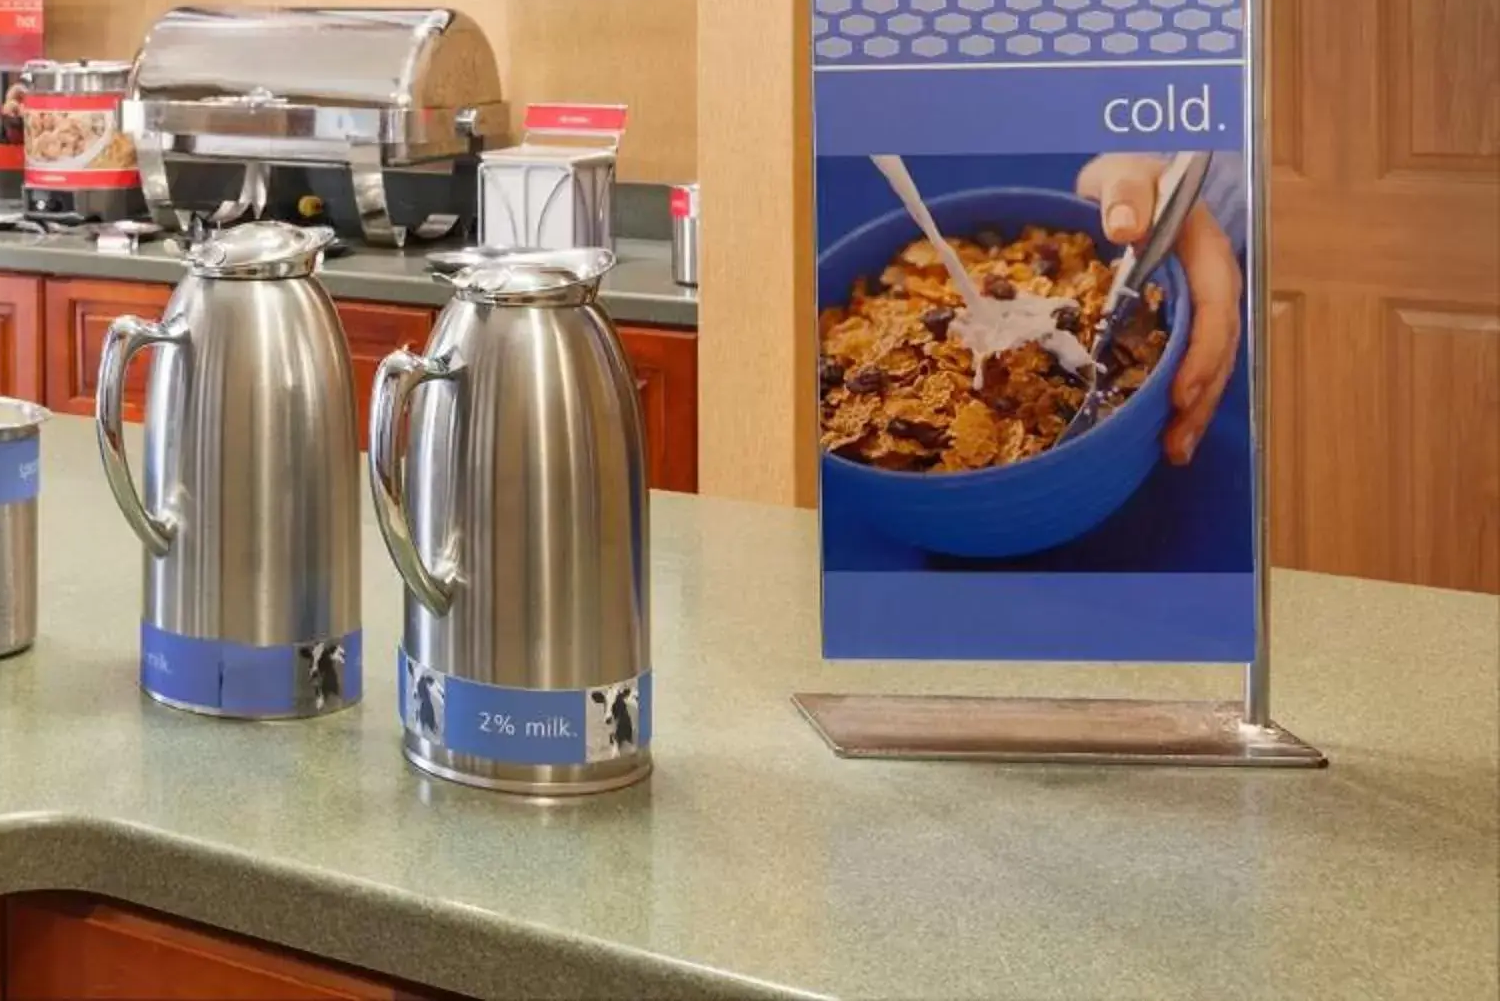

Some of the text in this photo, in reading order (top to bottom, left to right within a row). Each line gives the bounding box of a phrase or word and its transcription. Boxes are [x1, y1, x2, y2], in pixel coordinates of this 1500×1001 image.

[1103, 82, 1227, 133] cold.
[477, 711, 579, 739] 2% milk.
